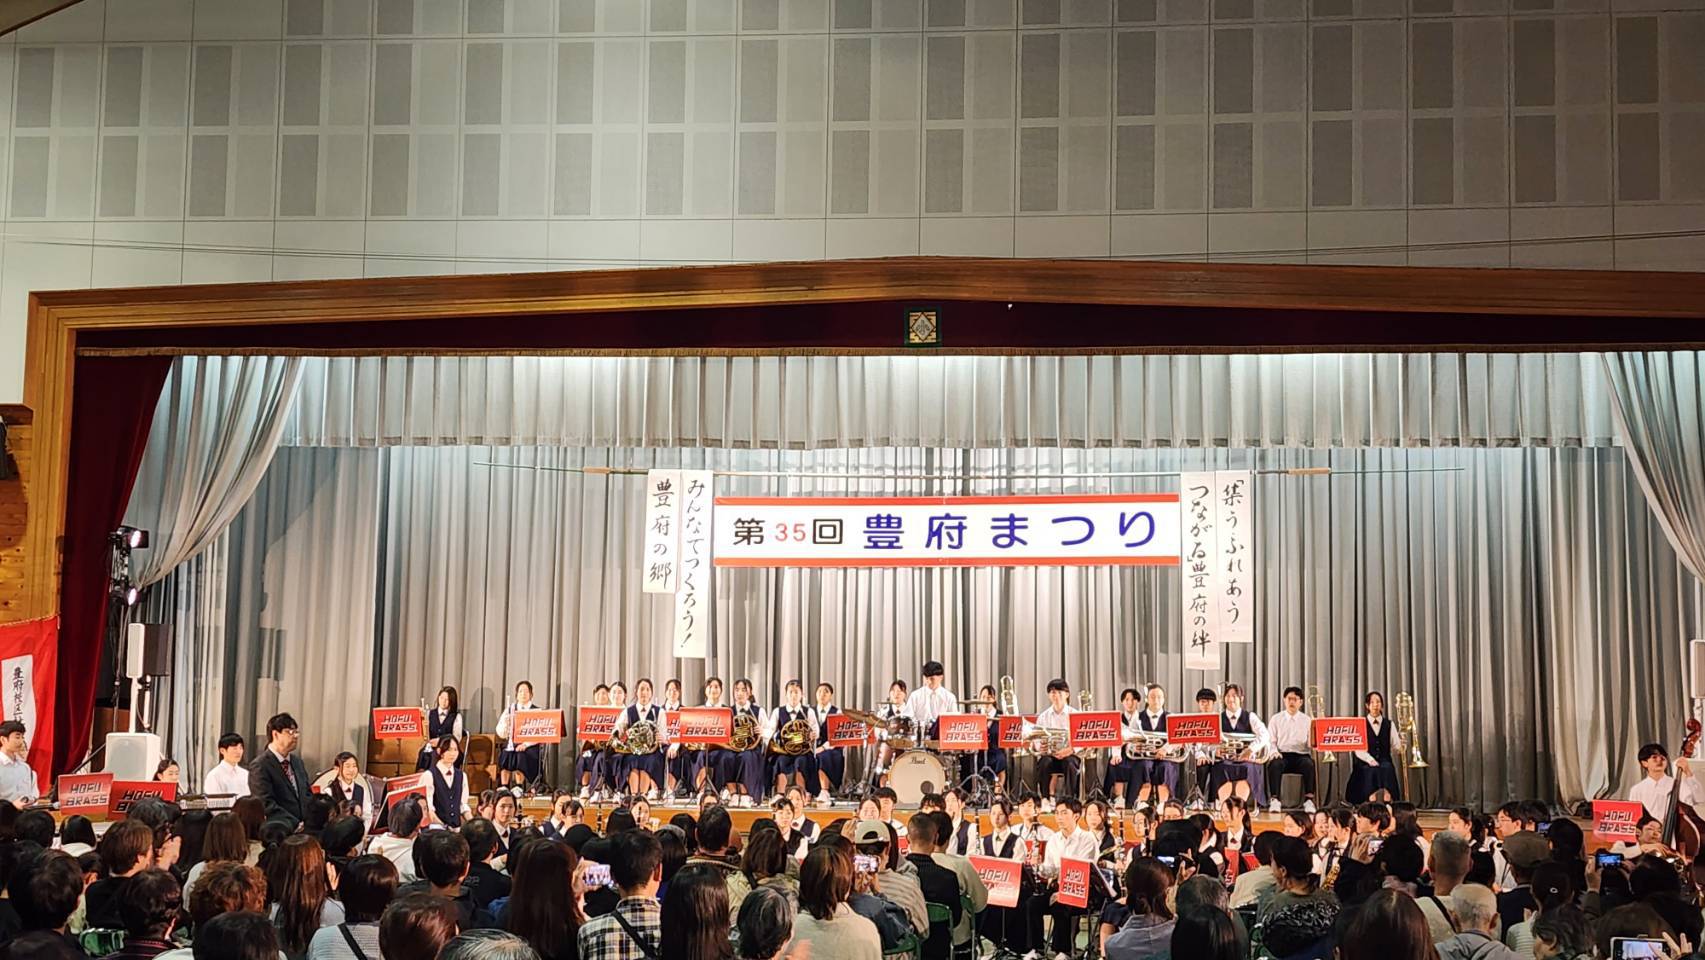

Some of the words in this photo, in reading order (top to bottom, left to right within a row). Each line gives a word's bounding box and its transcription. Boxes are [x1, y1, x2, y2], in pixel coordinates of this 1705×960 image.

[649, 478, 675, 590] 豊府の郷
[732, 516, 844, 547] 第35回
[862, 510, 1157, 552] 豊府まつり
[383, 714, 413, 723] HOFU
[522, 717, 554, 727] HOFU
[380, 723, 417, 732] BRASS
[584, 724, 614, 733] BRAS
[948, 721, 978, 732] HOFU
[1079, 719, 1111, 730] HOFU
[1176, 720, 1210, 729] HOFU
[1326, 725, 1355, 734] HOFU
[519, 726, 558, 736] BRASS
[685, 726, 725, 735] BRASS
[834, 730, 864, 739] BRAS
[1075, 730, 1117, 740] BRASS
[1174, 729, 1216, 738] BRASS
[945, 732, 983, 742] BRASS
[1322, 735, 1361, 744] BRASS
[70, 782, 102, 793] HOFU
[66, 794, 108, 806] BRASS
[1603, 810, 1632, 821] HOFU
[1598, 822, 1636, 834] BRASS
